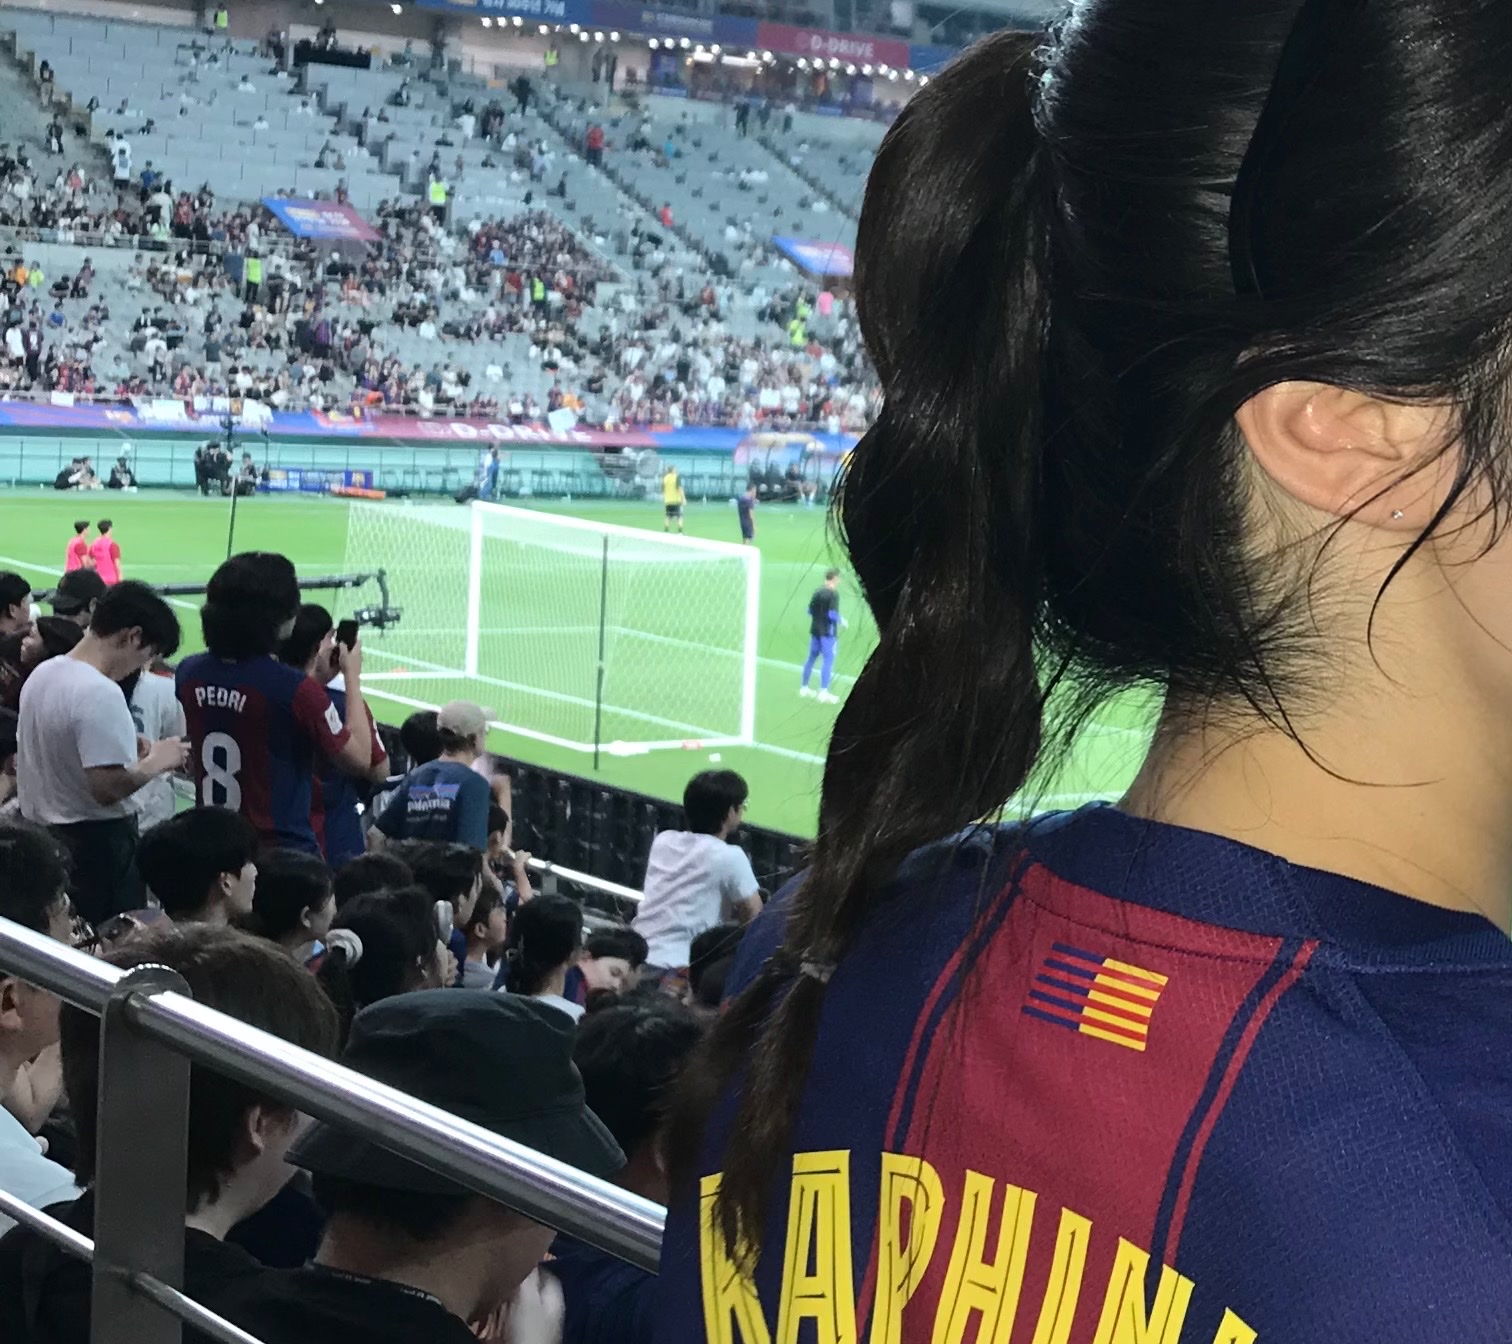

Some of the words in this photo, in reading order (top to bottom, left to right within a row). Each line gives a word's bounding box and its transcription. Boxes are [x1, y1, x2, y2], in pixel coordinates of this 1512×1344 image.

[810, 34, 875, 58] D-DRIVE
[194, 685, 247, 714] PEDRI
[201, 731, 242, 813] 8
